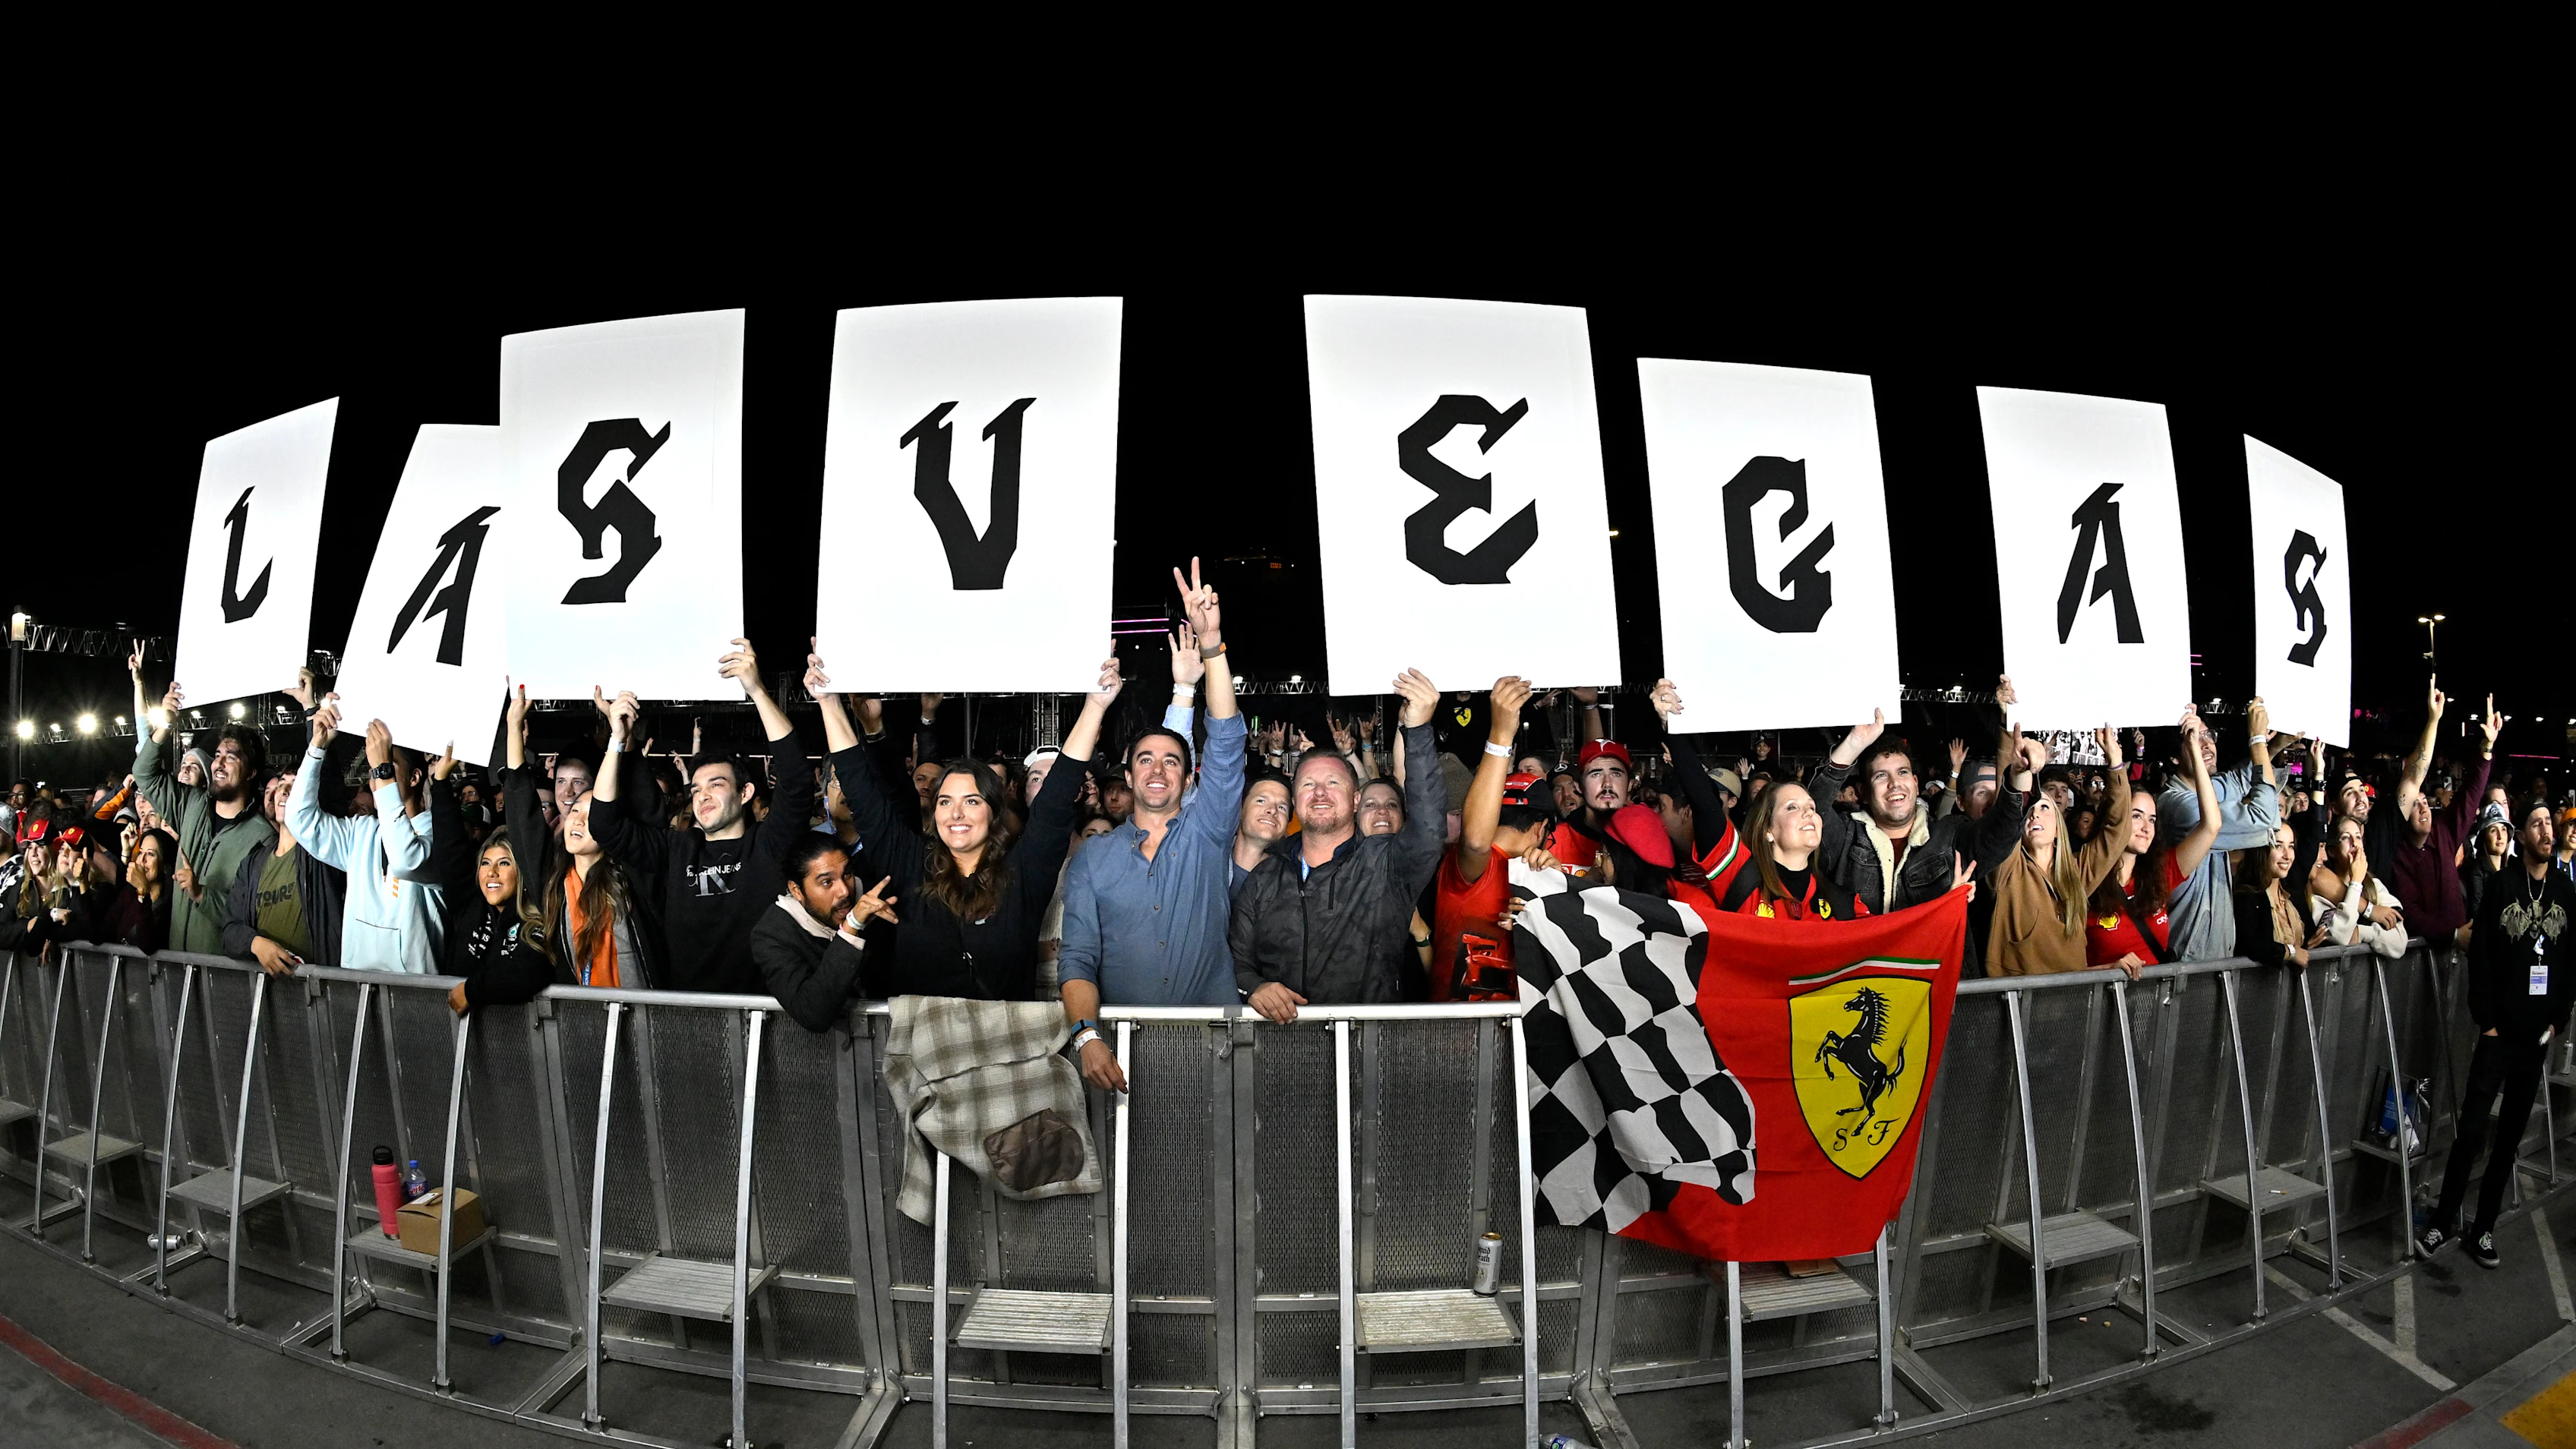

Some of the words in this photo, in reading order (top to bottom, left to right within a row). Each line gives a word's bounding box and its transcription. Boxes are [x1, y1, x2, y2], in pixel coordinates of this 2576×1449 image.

[557, 418, 671, 605] S
[899, 397, 1037, 591] V
[1397, 394, 1539, 586] E
[1722, 456, 1835, 634] G
[2057, 482, 2145, 645] A
[387, 506, 501, 667] A
[2284, 529, 2328, 668] S
